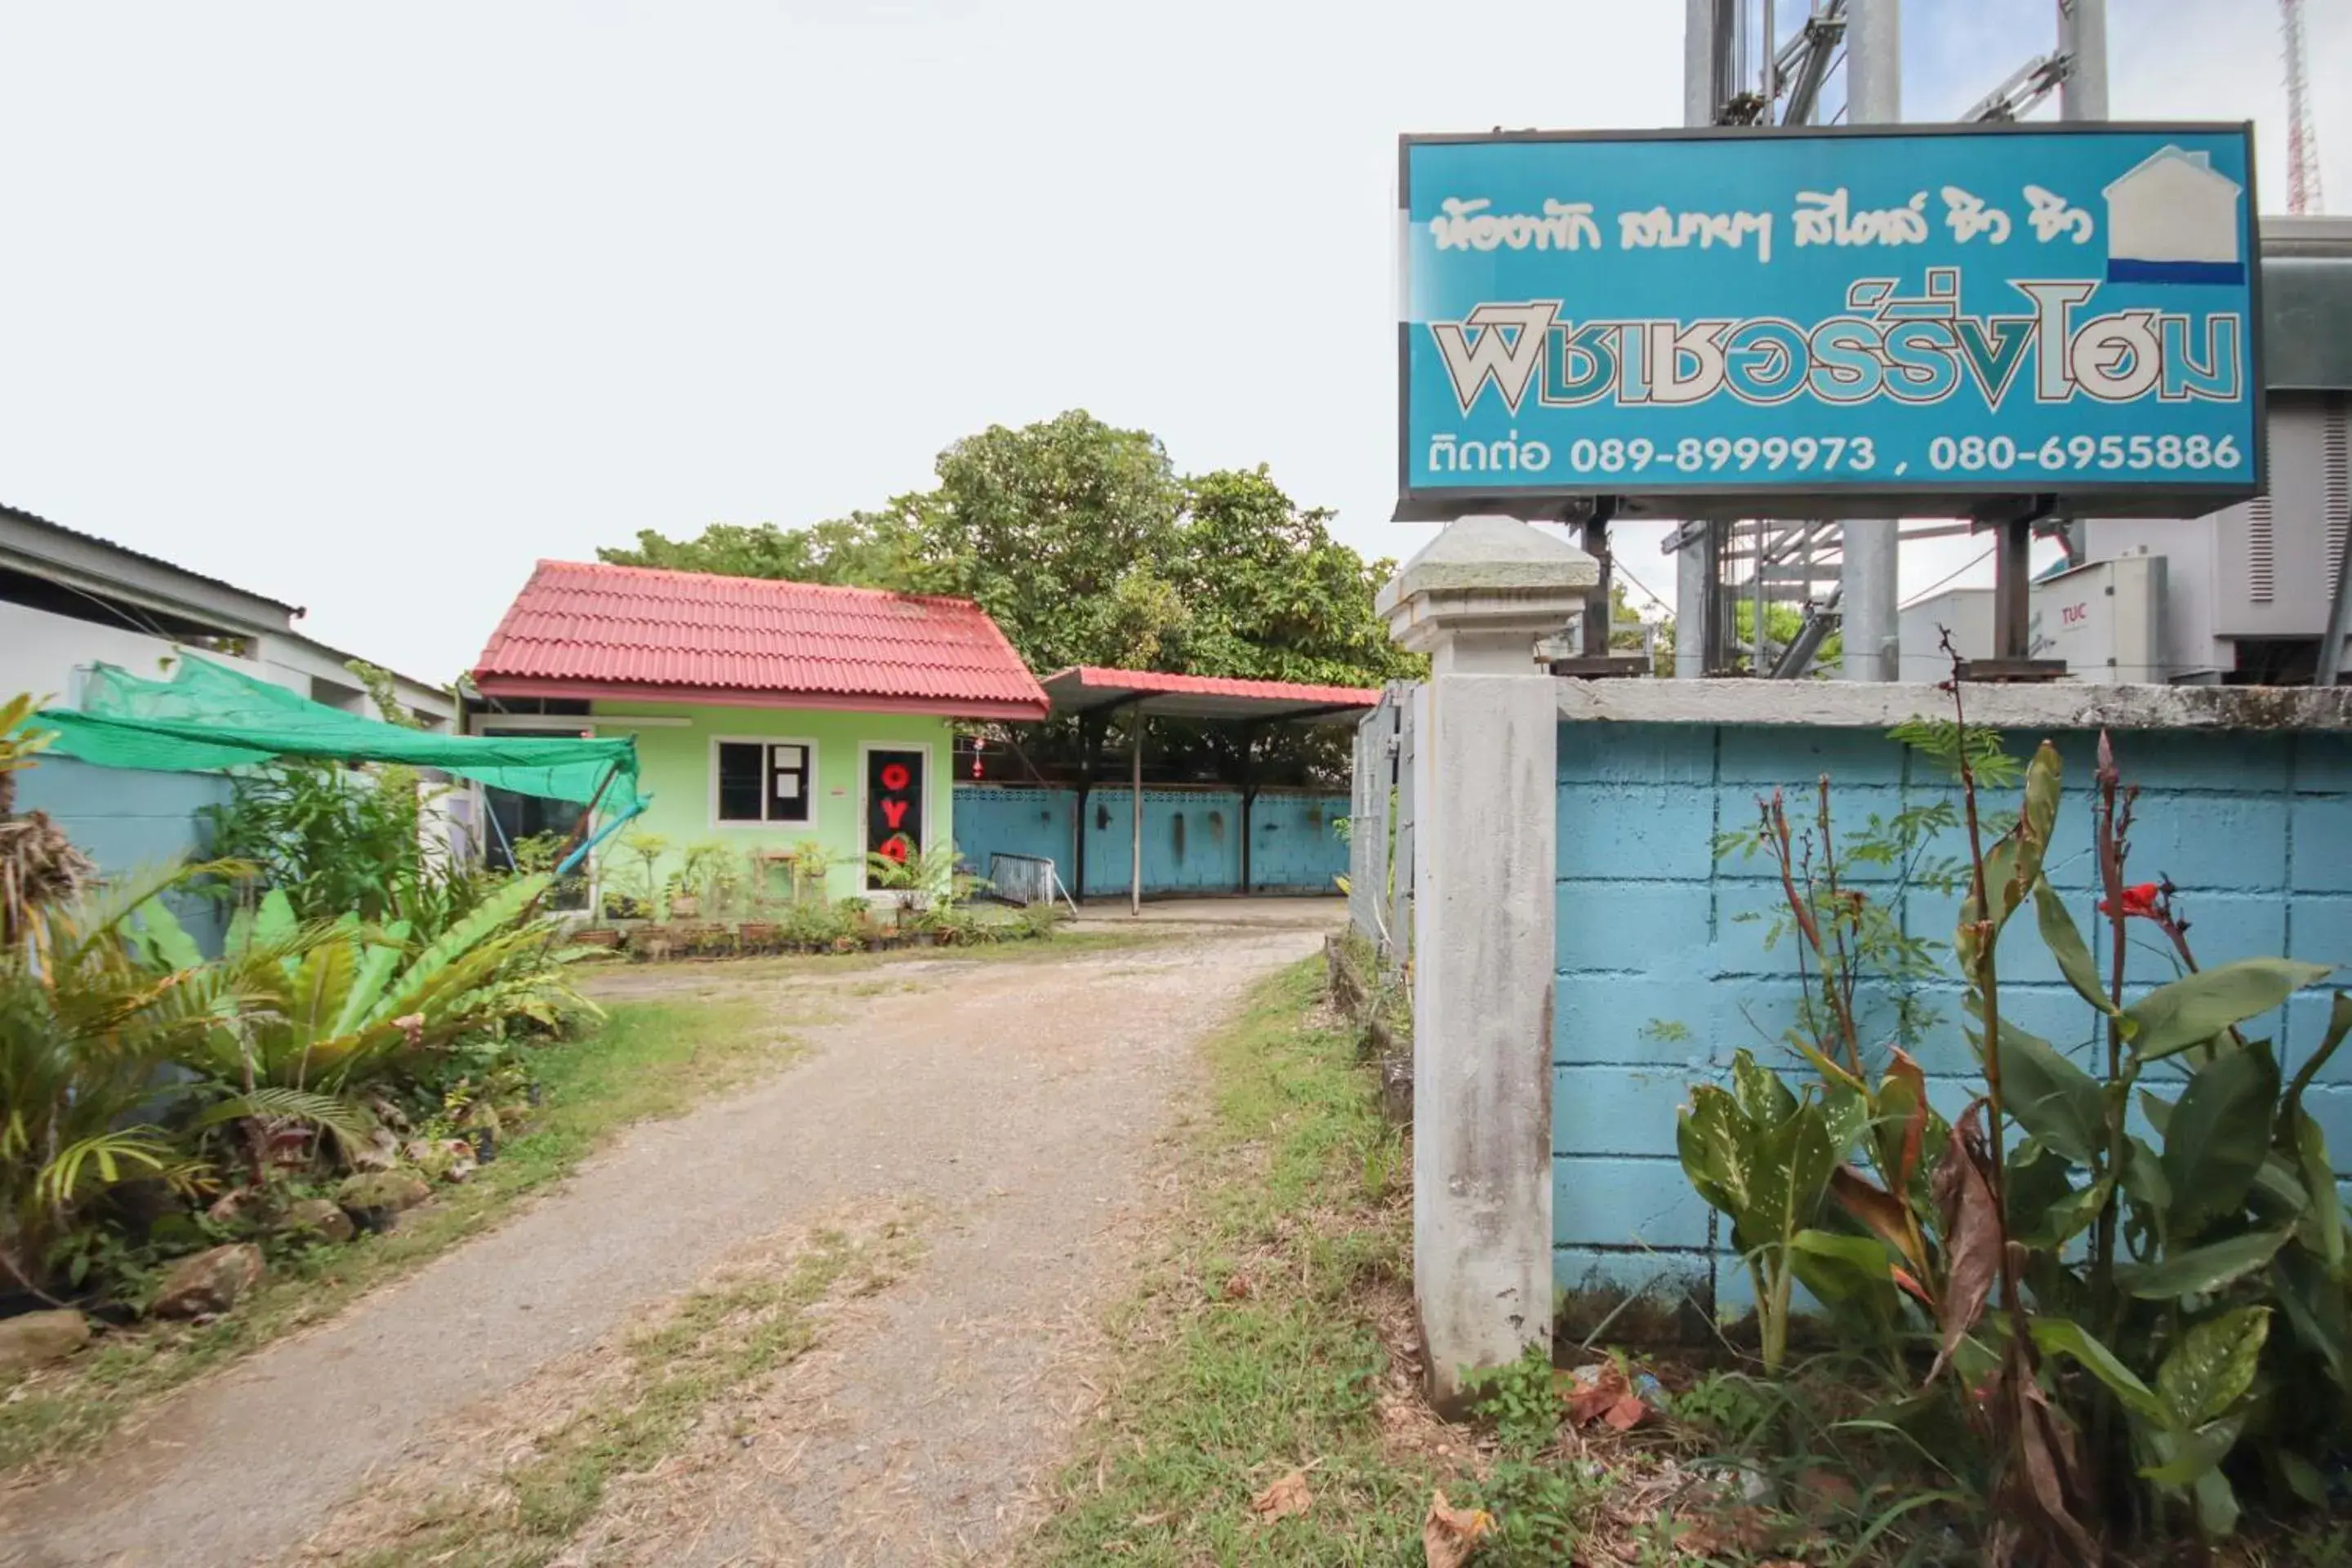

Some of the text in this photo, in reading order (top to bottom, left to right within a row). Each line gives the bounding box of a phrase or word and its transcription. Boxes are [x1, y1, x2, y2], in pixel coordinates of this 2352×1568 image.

[1428, 430, 1551, 471] ติดต่อ
[1570, 436, 1875, 472] 089-8999973
[1929, 435, 2240, 470] 080-6955886
[2061, 602, 2088, 626] TUC
